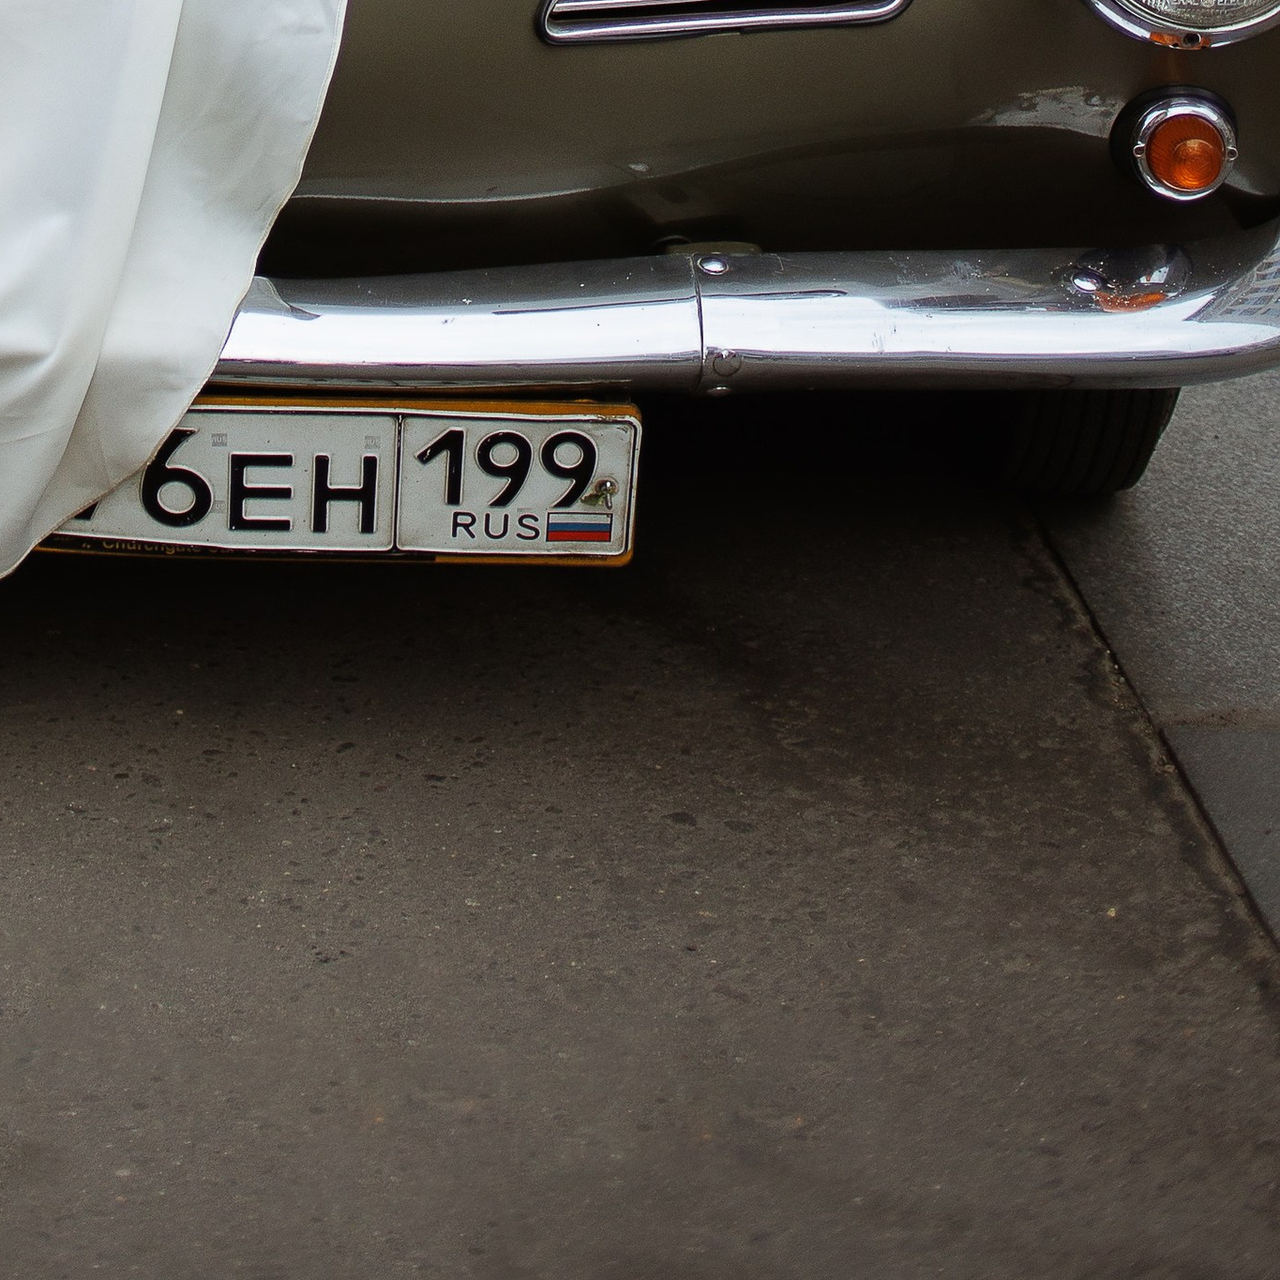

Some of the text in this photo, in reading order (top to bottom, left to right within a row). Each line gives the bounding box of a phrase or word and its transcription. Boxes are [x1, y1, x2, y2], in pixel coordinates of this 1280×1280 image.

[74, 427, 599, 533] 6EH 199
[451, 512, 542, 540] RUS
